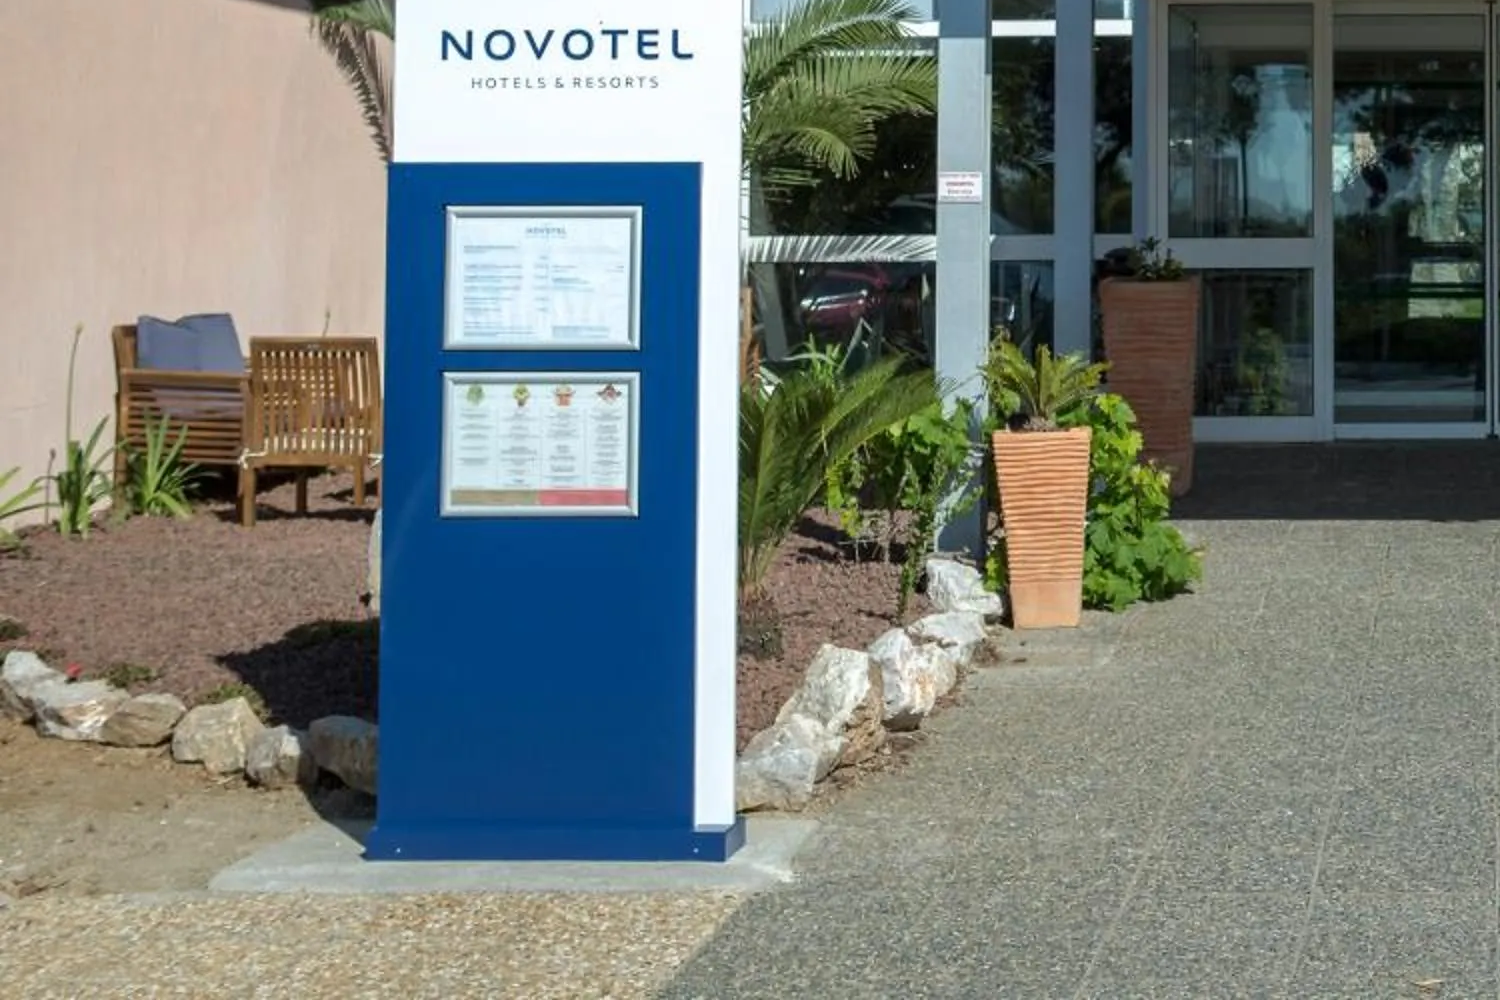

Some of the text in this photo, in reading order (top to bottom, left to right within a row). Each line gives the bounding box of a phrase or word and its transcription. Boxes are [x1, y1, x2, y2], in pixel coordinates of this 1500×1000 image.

[440, 28, 695, 62] NOVOTEL
[471, 75, 660, 90] HOTELS & RESORTS
